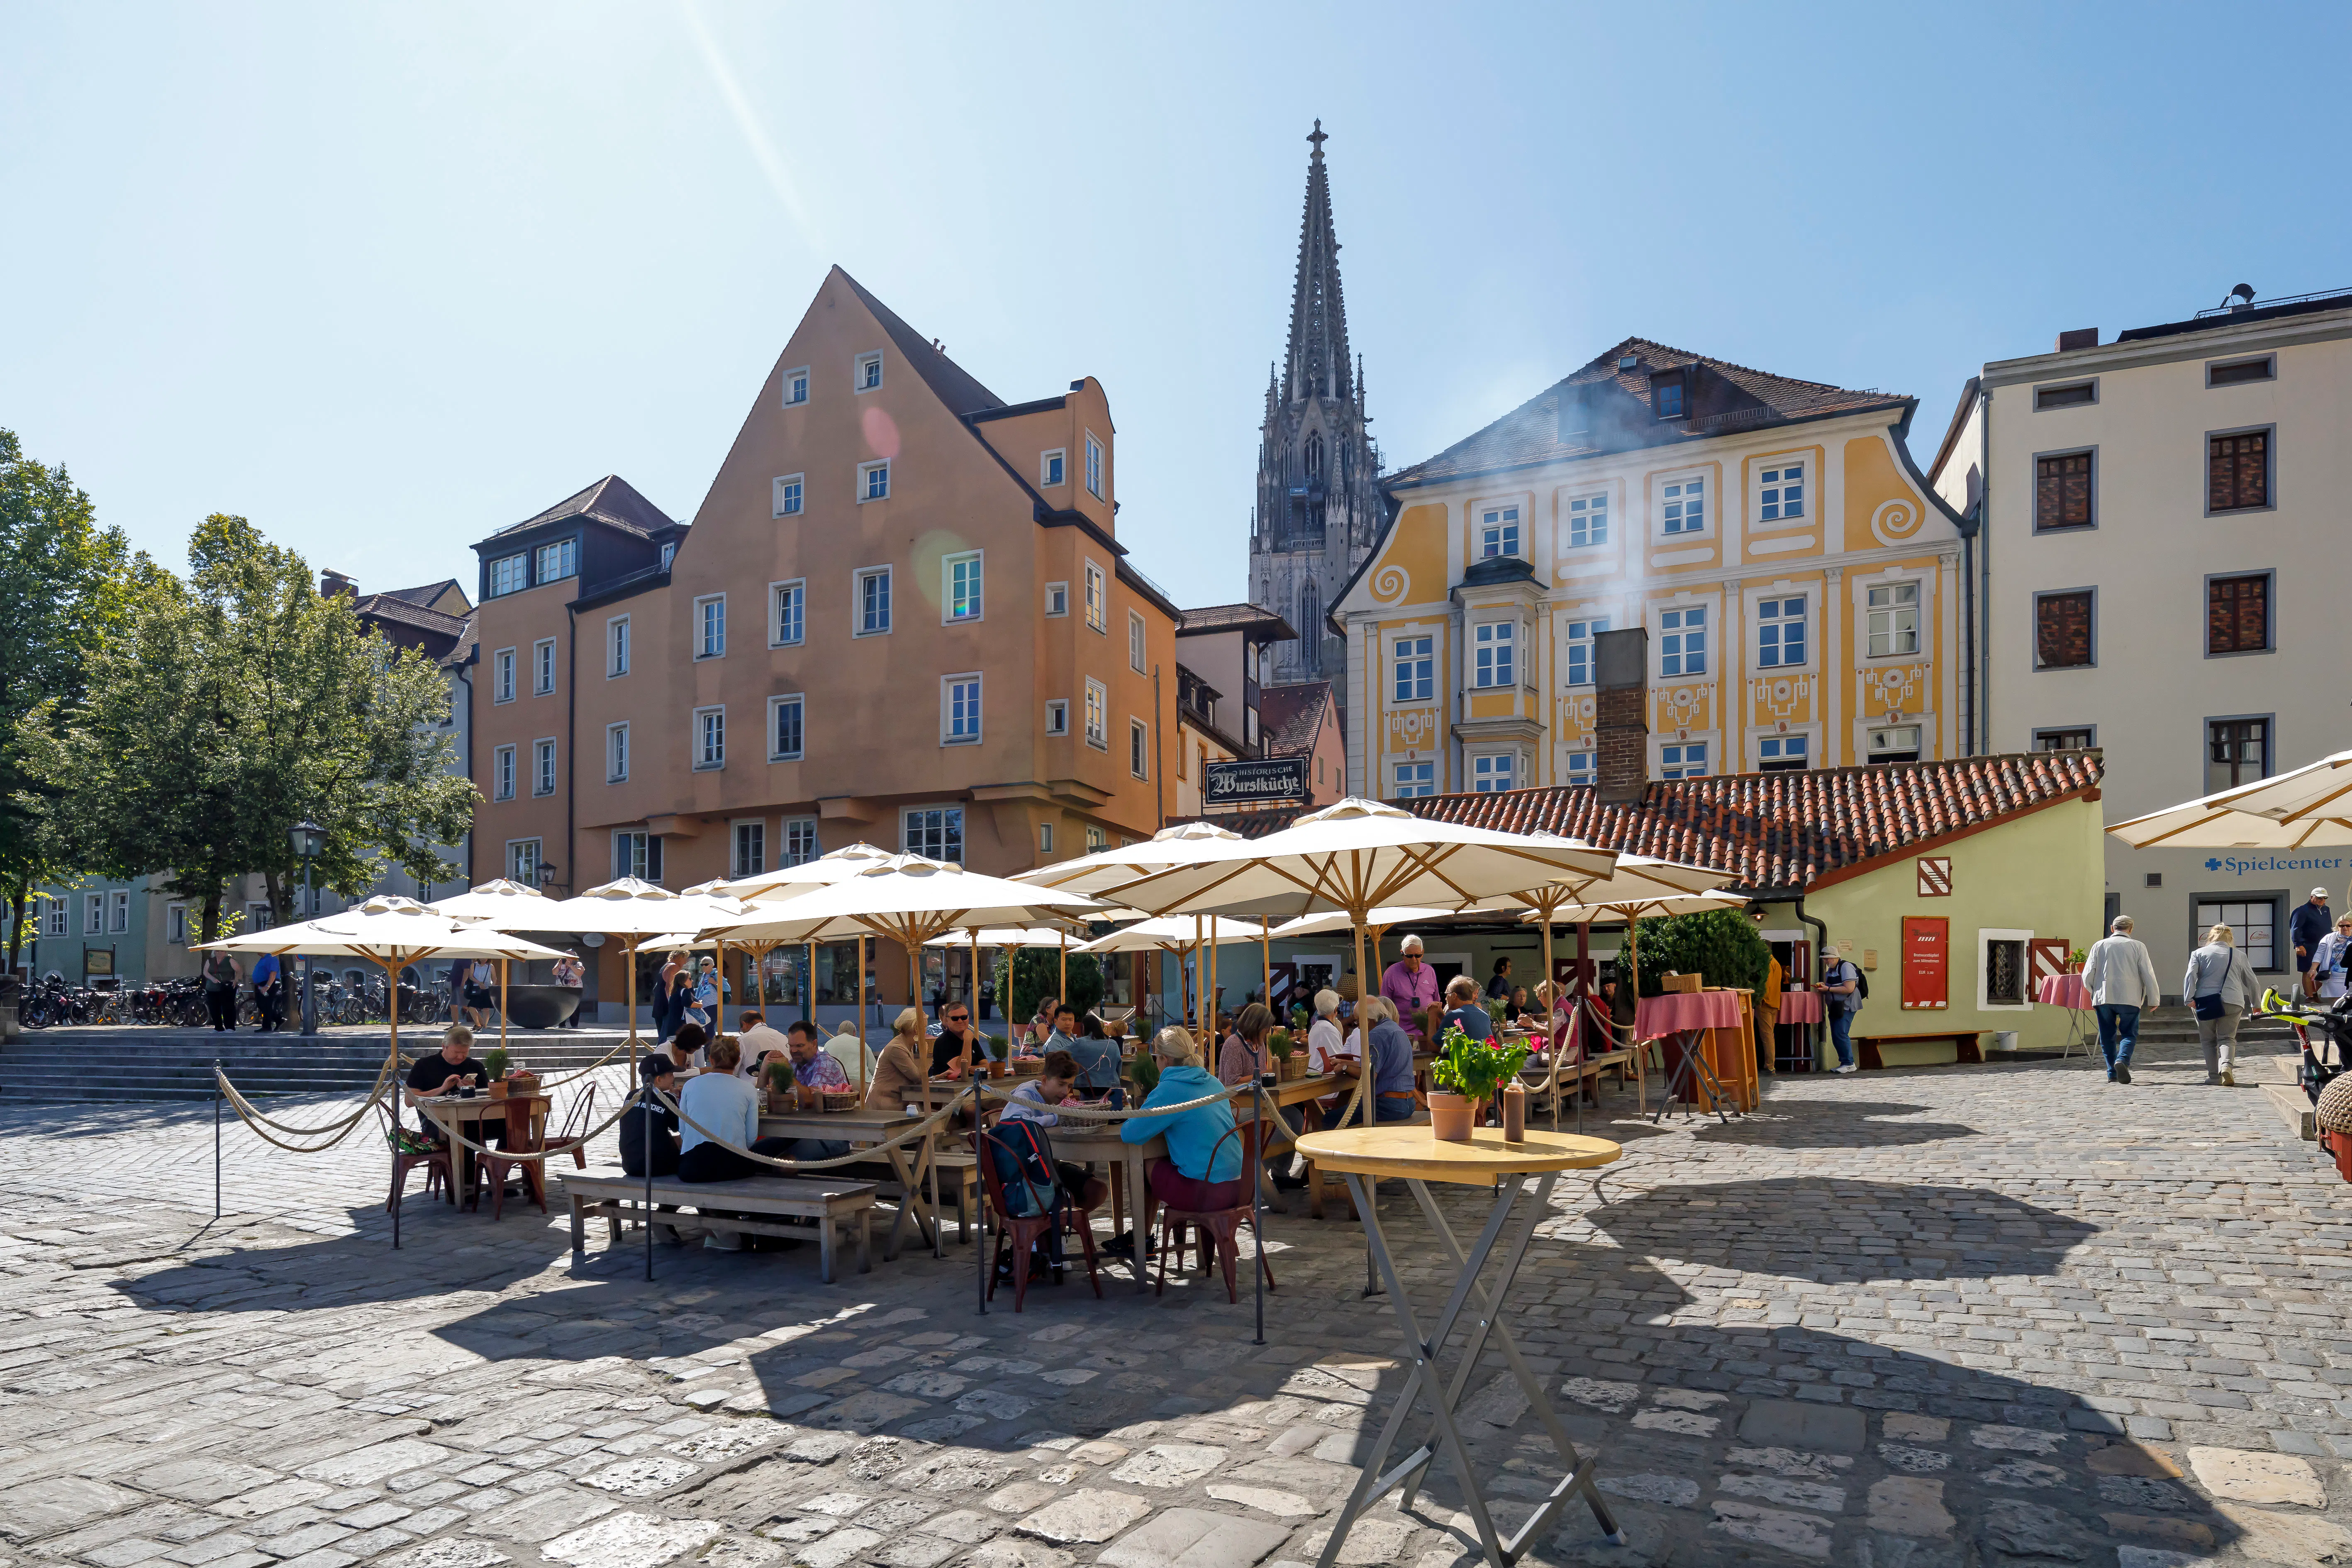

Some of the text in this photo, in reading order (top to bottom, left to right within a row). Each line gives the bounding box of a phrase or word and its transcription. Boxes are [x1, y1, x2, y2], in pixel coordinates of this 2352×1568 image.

[1239, 766, 1293, 775] HISTORISCHE
[1209, 766, 1301, 795] Wurstküche
[2225, 856, 2342, 875] Spielcenter
[641, 1102, 665, 1114] MCHEN
